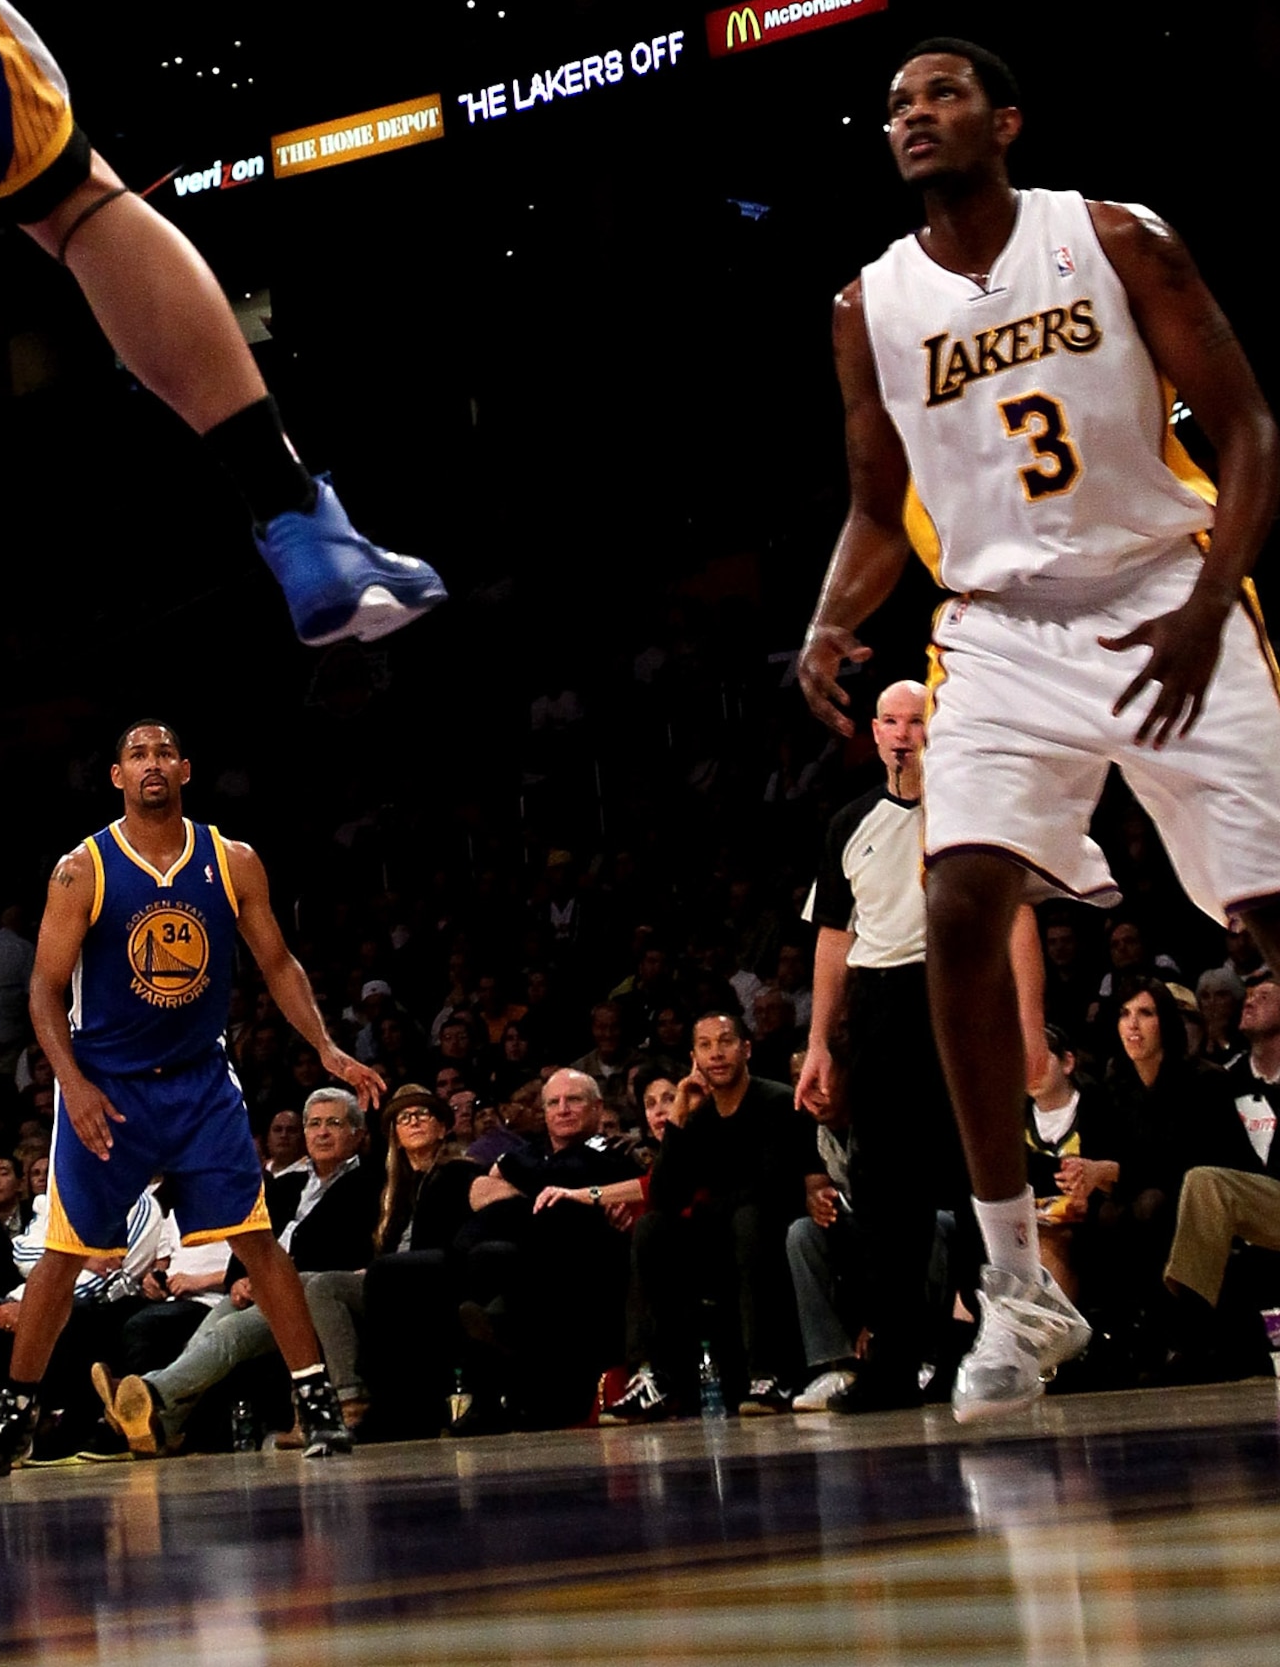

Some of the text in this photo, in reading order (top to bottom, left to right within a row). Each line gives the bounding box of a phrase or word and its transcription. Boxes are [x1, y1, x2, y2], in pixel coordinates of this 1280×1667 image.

[512, 49, 624, 112] LAKERS
[630, 30, 684, 76] OFF
[276, 106, 439, 167] THE HOME DEPOT
[173, 155, 265, 197] verizon
[923, 299, 1102, 408] LAKERS
[996, 390, 1083, 503] 3
[125, 899, 208, 931] GOLDEN STATE
[161, 923, 192, 944] 34
[130, 974, 212, 1010] WARRIORS
